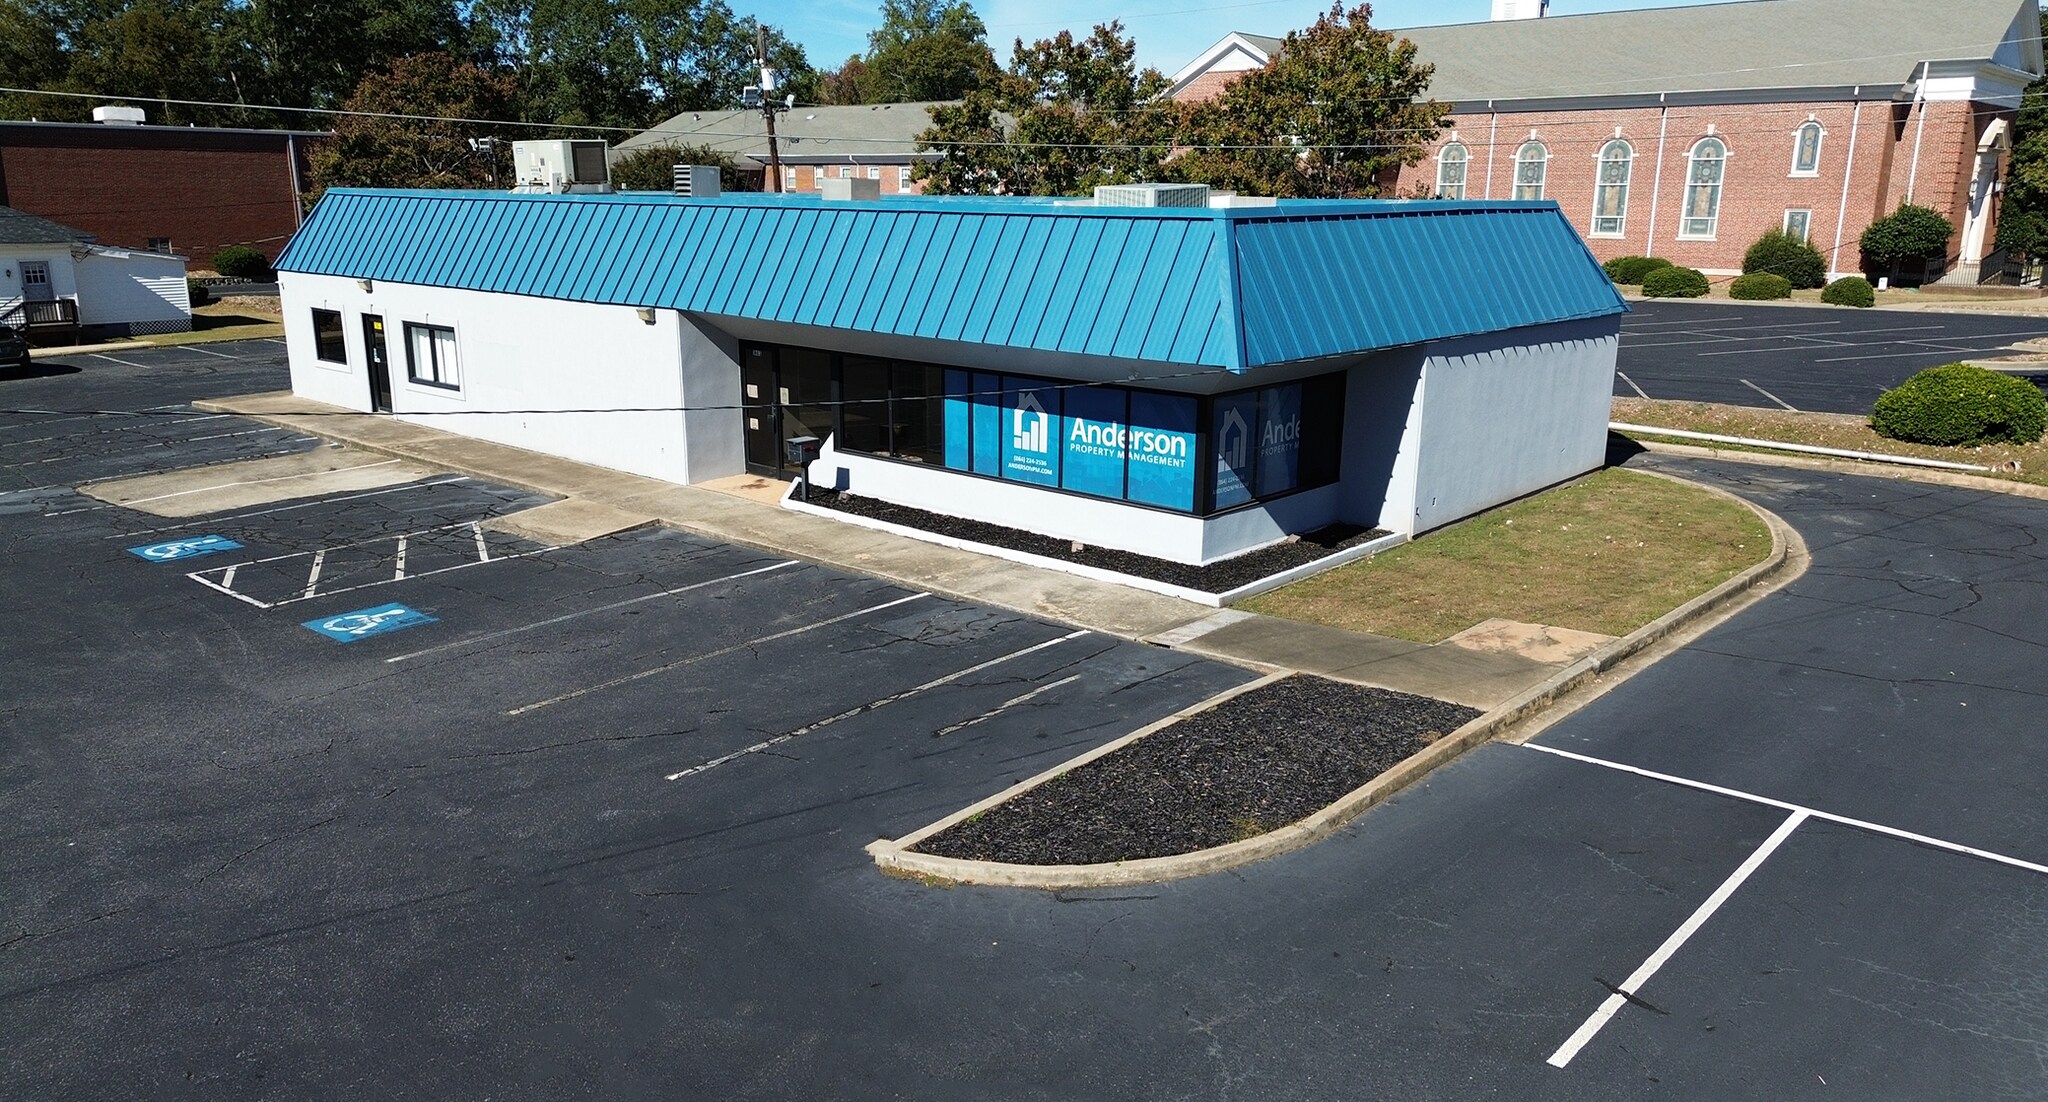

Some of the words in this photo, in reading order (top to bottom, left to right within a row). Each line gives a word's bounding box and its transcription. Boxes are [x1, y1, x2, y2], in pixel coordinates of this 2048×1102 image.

[1070, 417, 1186, 457] Anderson
[1070, 443, 1115, 457] PROPERTY
[1117, 450, 1186, 468] MANAGEMENT
[1261, 443, 1292, 457] PROPERTY
